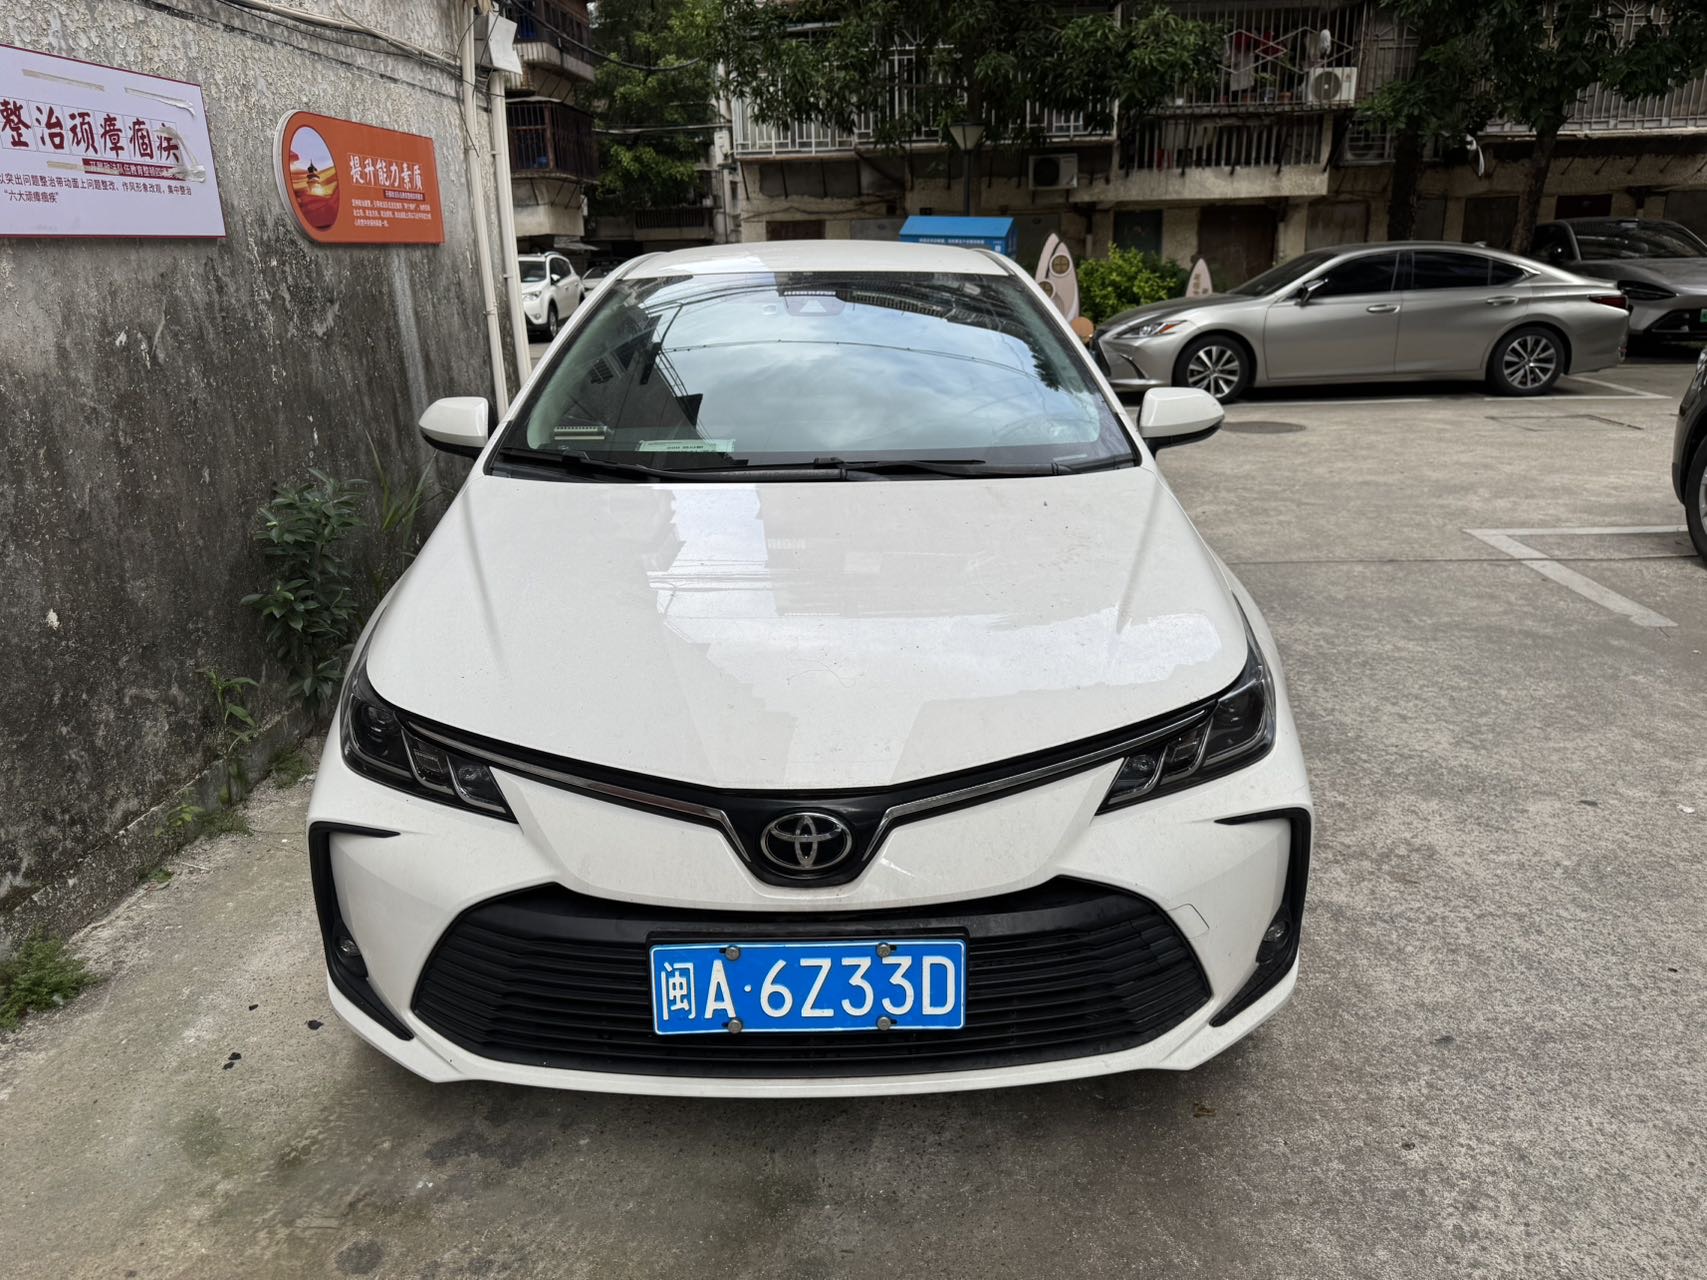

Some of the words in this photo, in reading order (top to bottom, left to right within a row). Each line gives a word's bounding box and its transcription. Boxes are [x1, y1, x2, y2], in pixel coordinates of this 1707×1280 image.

[0, 99, 179, 163] 整治顽瘴痼疾
[350, 155, 423, 191] 提升能力素质
[660, 955, 956, 1020] 闽A·6Z33D
